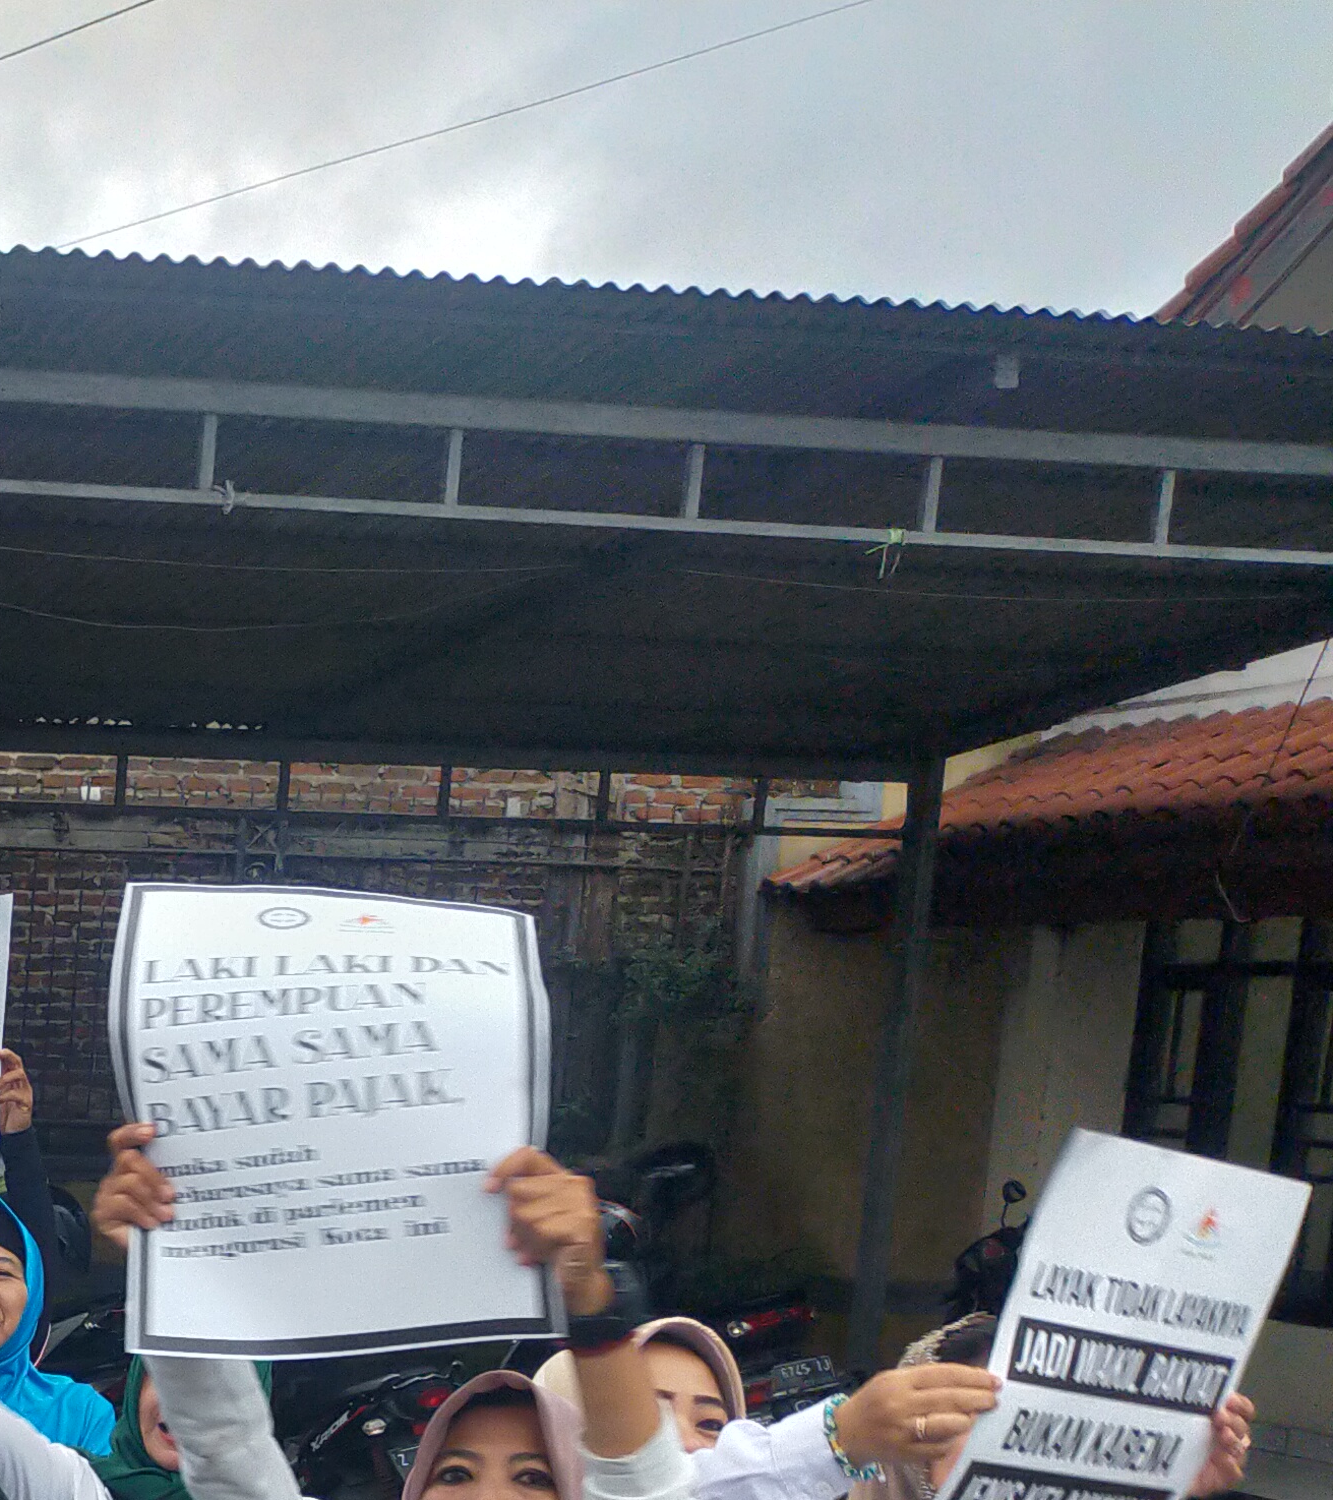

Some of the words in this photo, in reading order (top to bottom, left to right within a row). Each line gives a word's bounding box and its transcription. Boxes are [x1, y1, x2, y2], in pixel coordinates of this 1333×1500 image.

[140, 954, 259, 985] LAKI
[273, 955, 393, 976] LAKI
[408, 955, 513, 977] DAN
[140, 981, 427, 1030] PEREMPUAN
[141, 1035, 278, 1084] SAMA
[290, 1019, 440, 1065] SAMA
[146, 1084, 294, 1139] BAYAR
[303, 1067, 465, 1119] PAJAK
[1014, 1326, 1076, 1381] JADI
[1073, 1337, 1147, 1394] WAKIL
